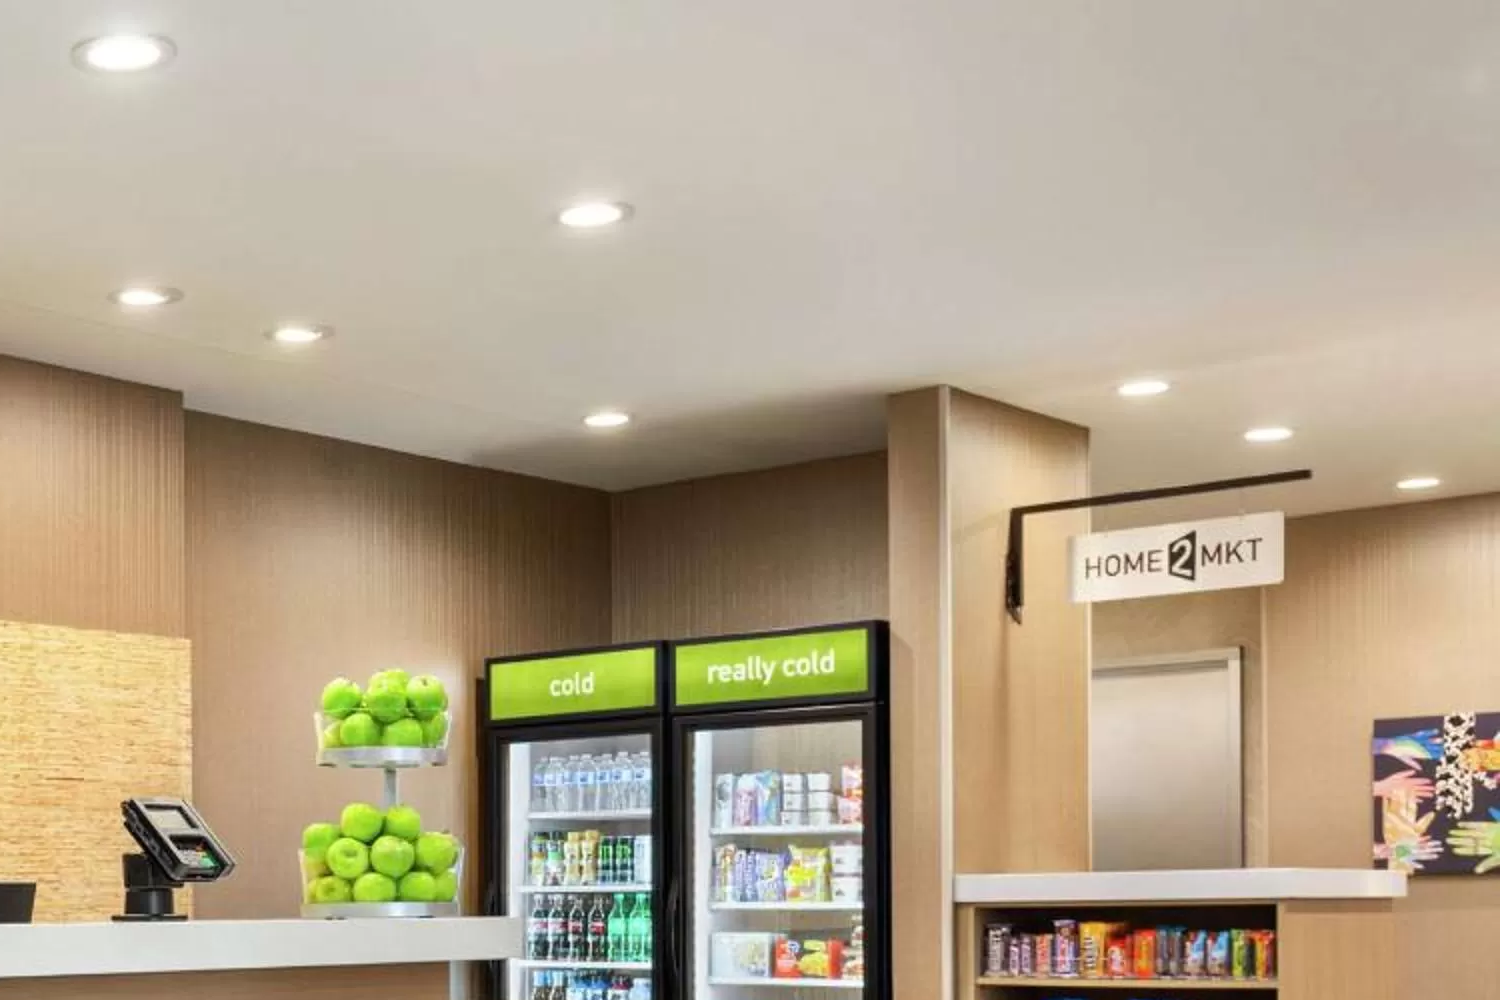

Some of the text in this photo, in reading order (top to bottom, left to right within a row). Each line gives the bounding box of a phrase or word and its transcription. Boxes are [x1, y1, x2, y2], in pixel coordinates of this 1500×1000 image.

[707, 649, 836, 685] really cold
[549, 671, 595, 698] cold
